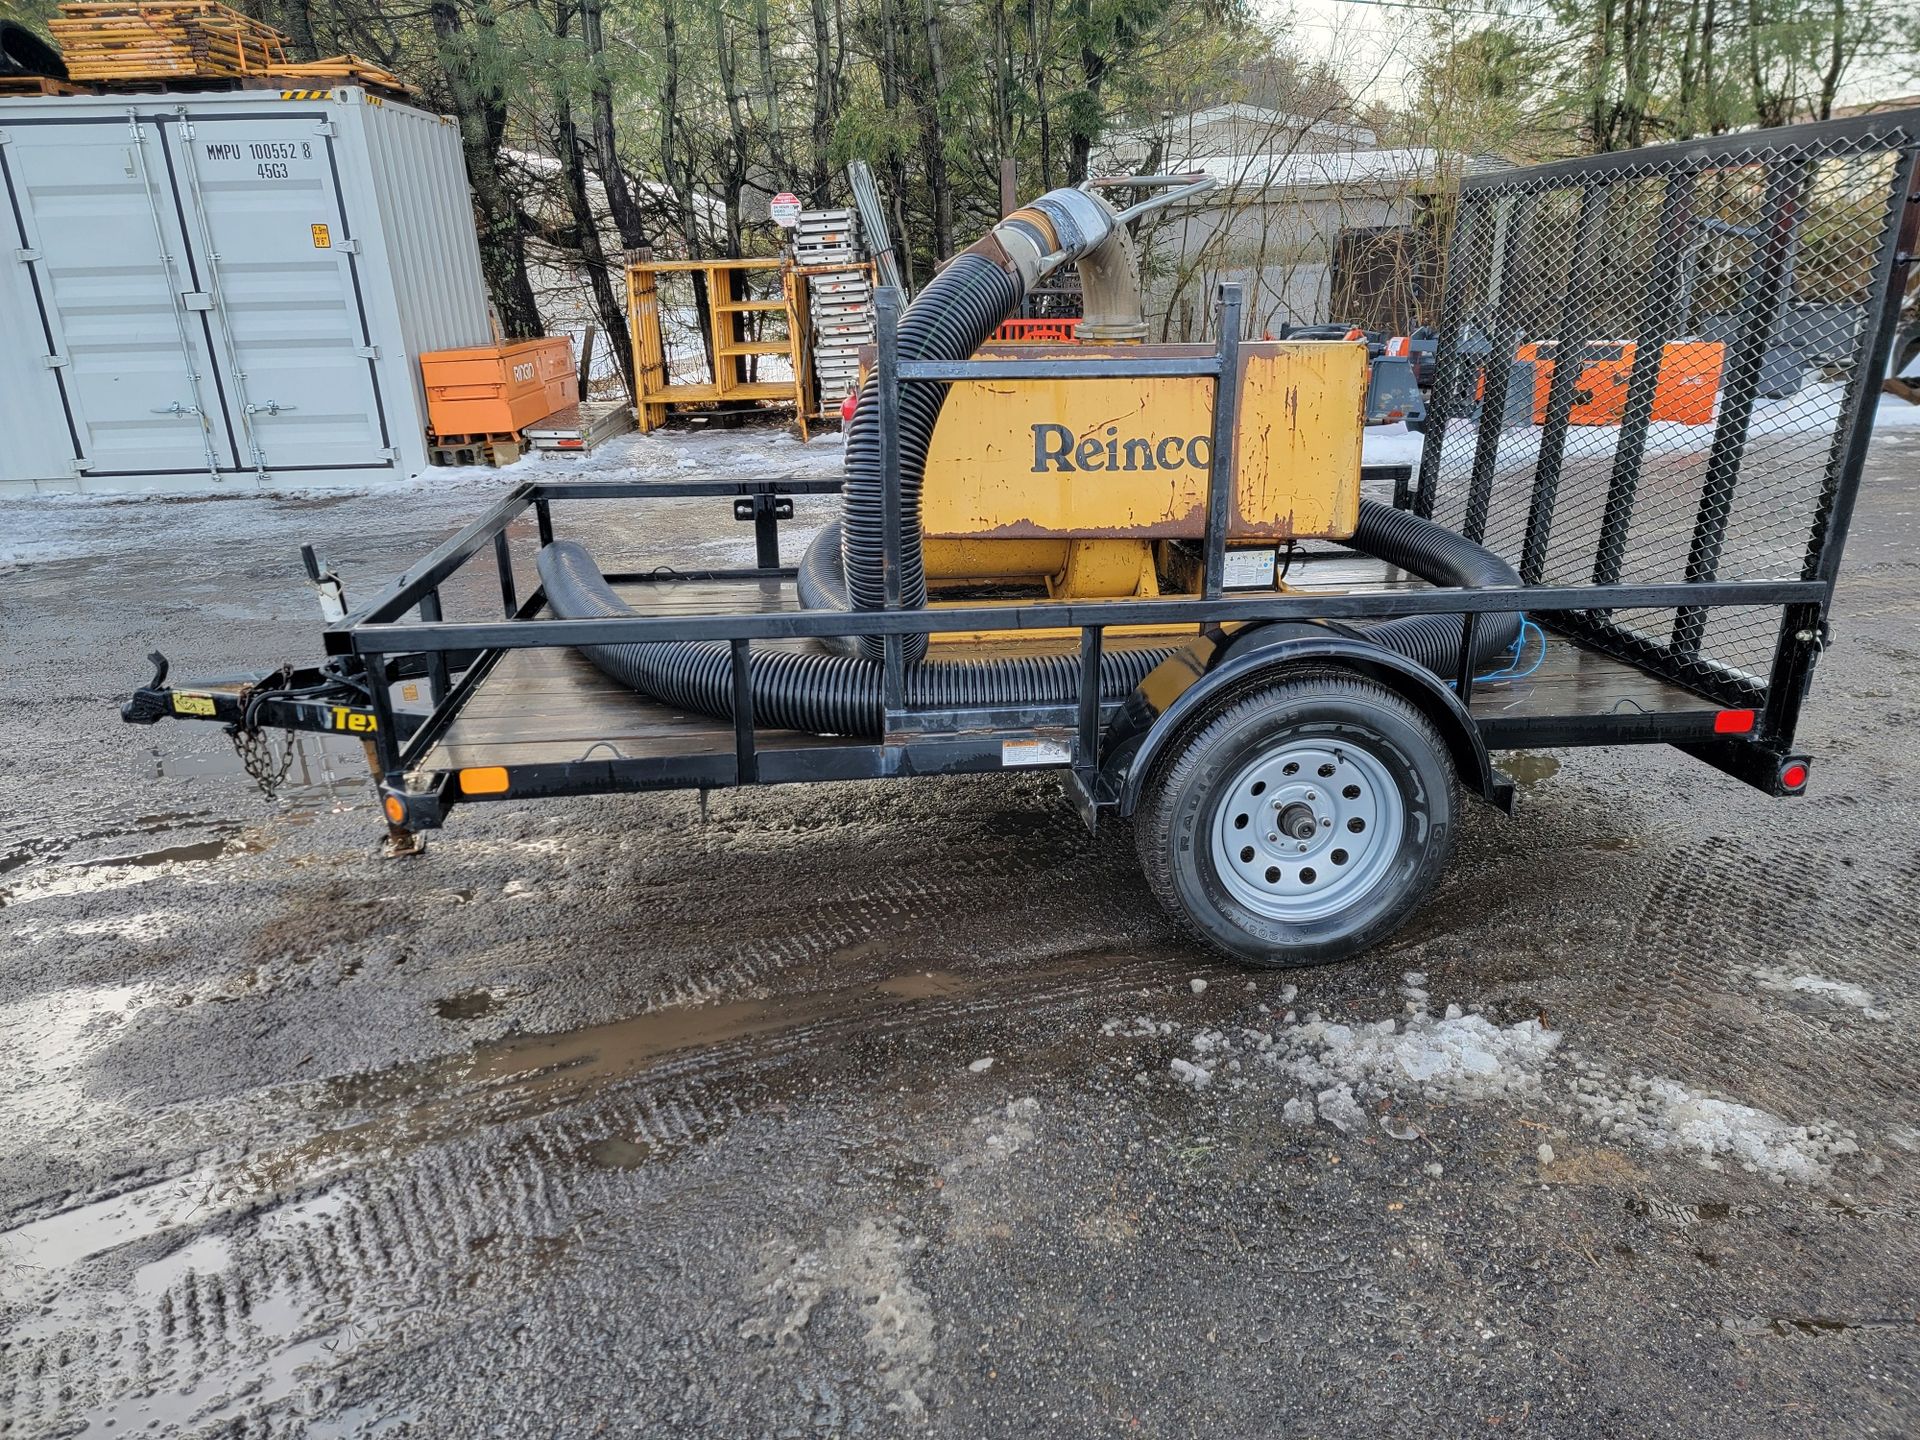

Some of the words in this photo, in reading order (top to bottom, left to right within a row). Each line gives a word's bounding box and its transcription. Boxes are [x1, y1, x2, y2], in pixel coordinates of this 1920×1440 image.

[206, 144, 241, 160] MMPU
[249, 143, 297, 159] 100552
[302, 142, 312, 159] 8
[257, 163, 289, 179] 45G3
[1031, 424, 1212, 473] Reinco
